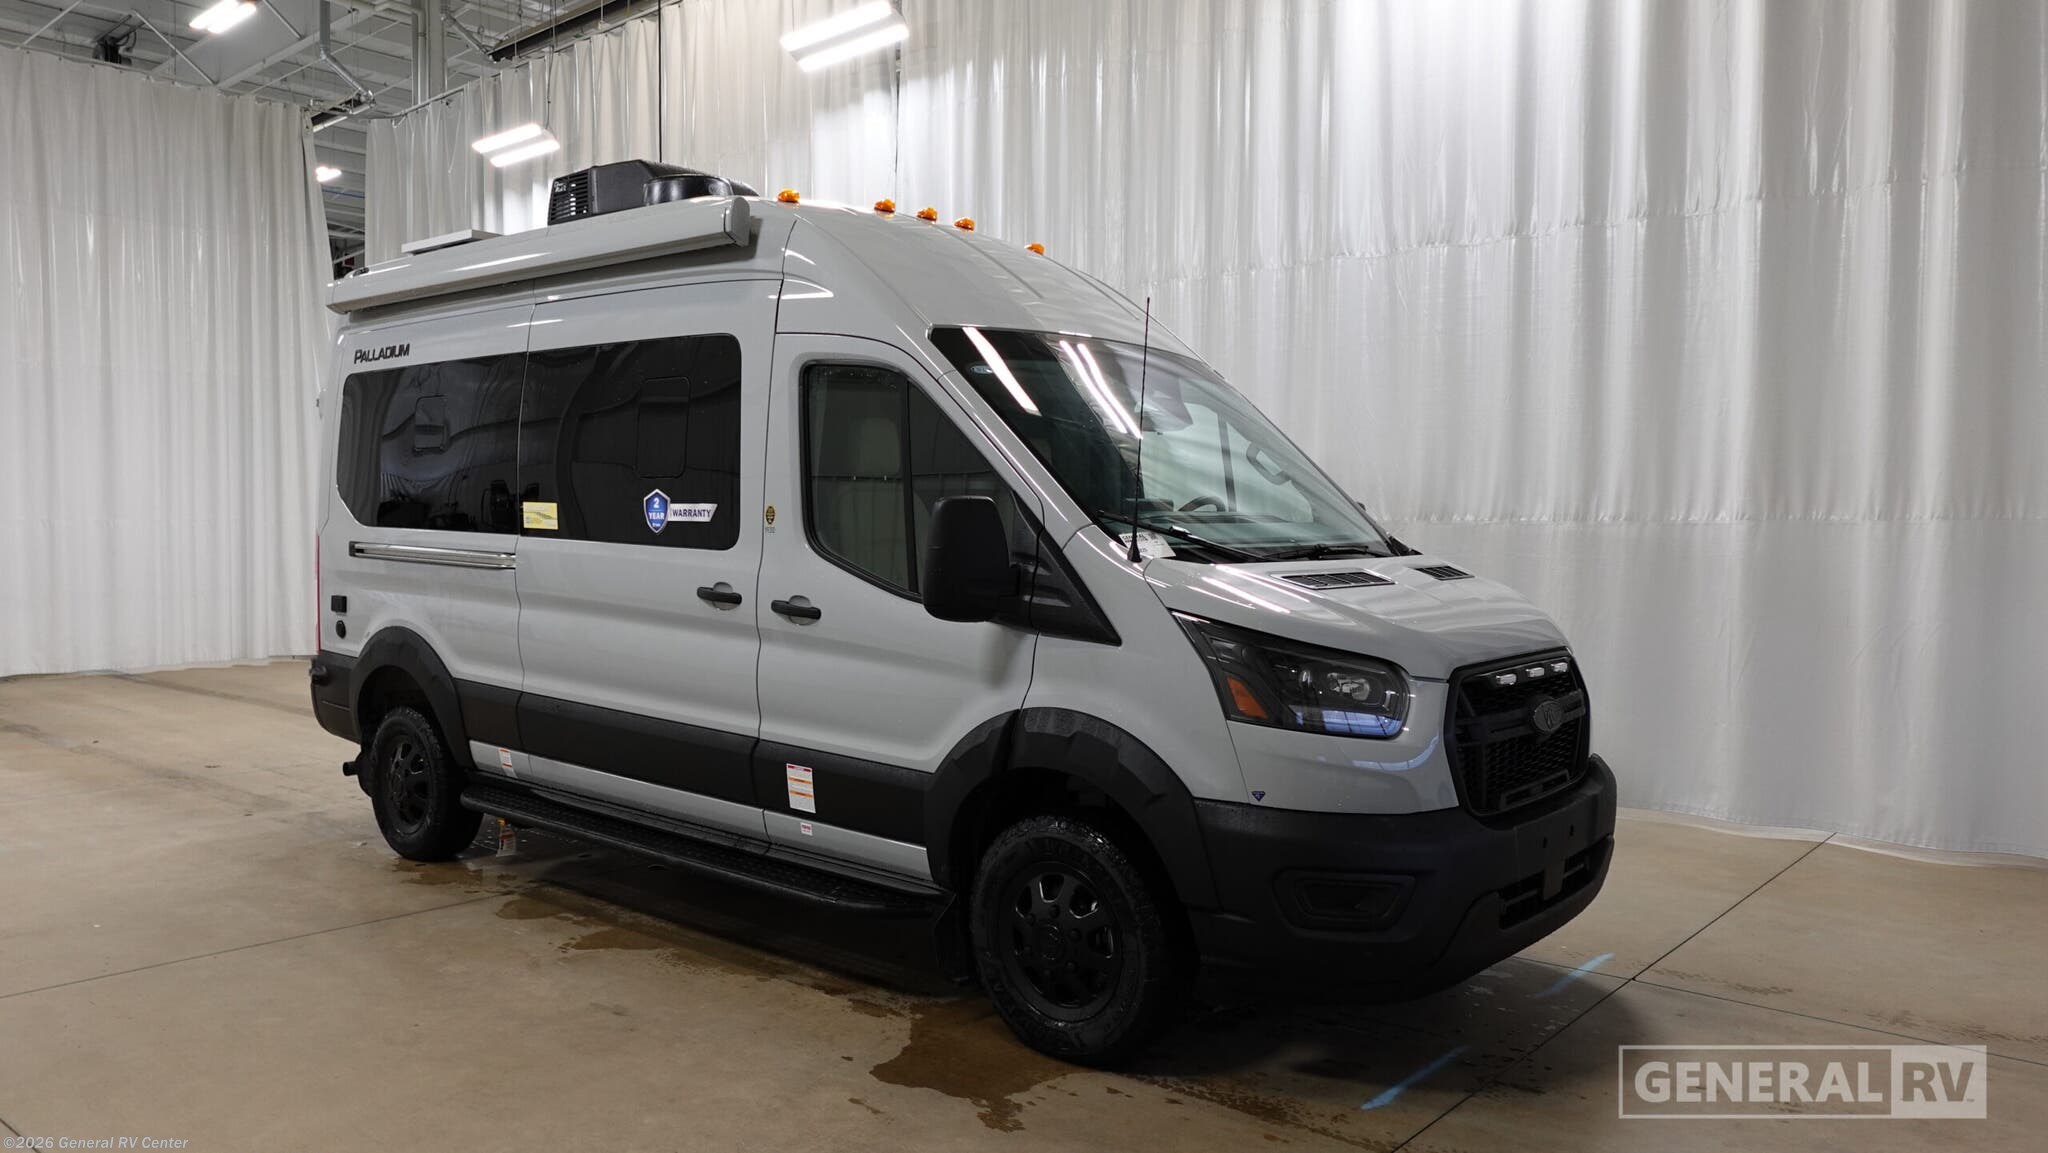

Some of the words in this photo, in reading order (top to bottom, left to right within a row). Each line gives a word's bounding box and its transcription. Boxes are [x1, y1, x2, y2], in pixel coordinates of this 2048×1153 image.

[354, 343, 410, 364] PALLADIUM
[653, 497, 660, 508] 2
[648, 511, 665, 520] YEAR
[672, 508, 712, 518] WARRANTY
